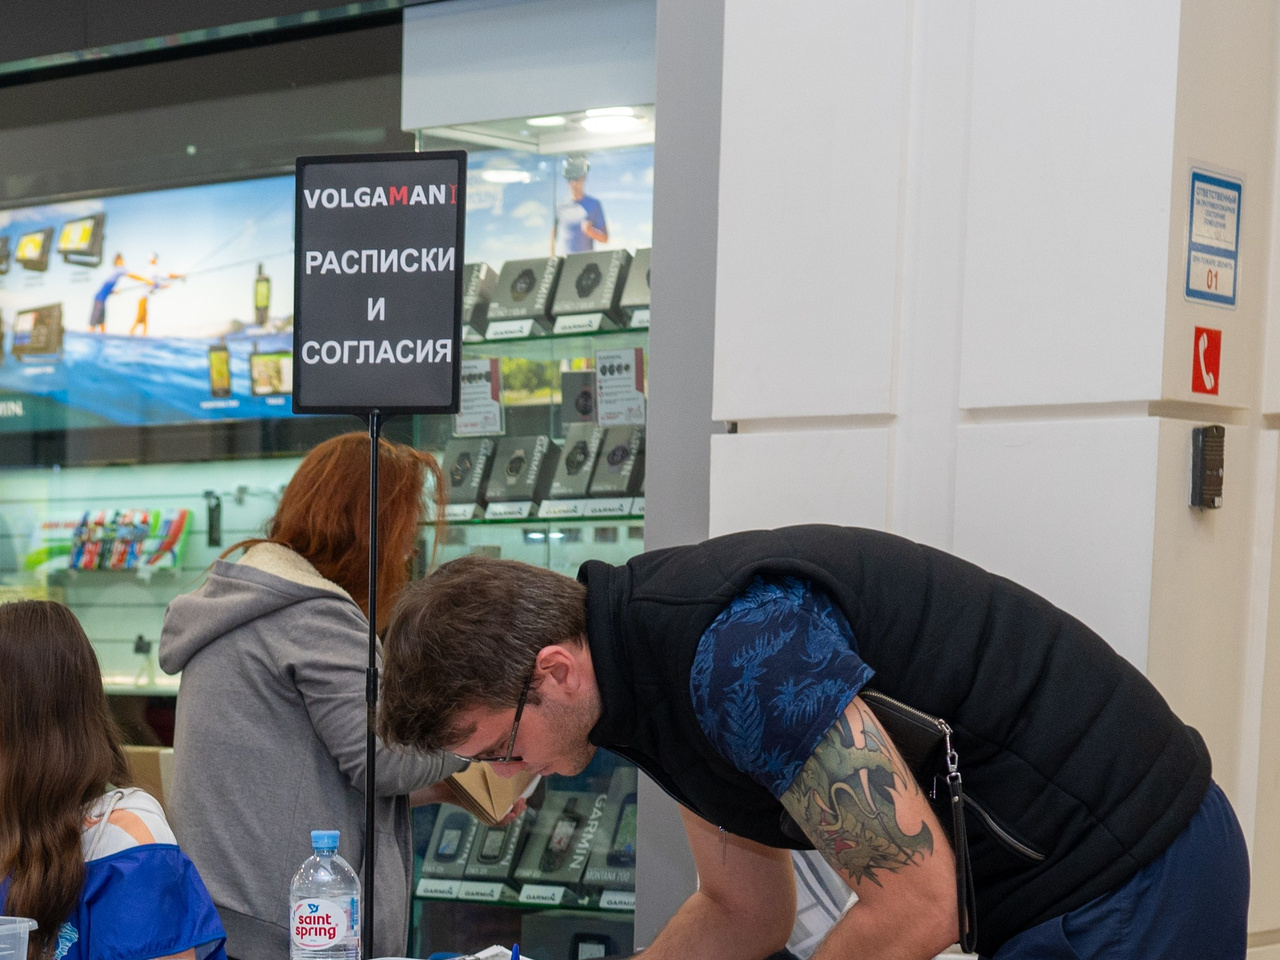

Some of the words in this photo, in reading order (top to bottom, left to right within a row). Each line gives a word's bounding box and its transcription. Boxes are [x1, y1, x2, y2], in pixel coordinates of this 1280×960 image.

[303, 184, 446, 209] VOLGAMAN
[306, 247, 455, 275] РАСПИСКИ
[1206, 268, 1218, 291] 01
[367, 297, 385, 321] И
[301, 339, 452, 365] СОГЛАСИЯ
[569, 793, 608, 870] GARMIN
[298, 914, 331, 925] saint
[295, 926, 336, 940] spring
